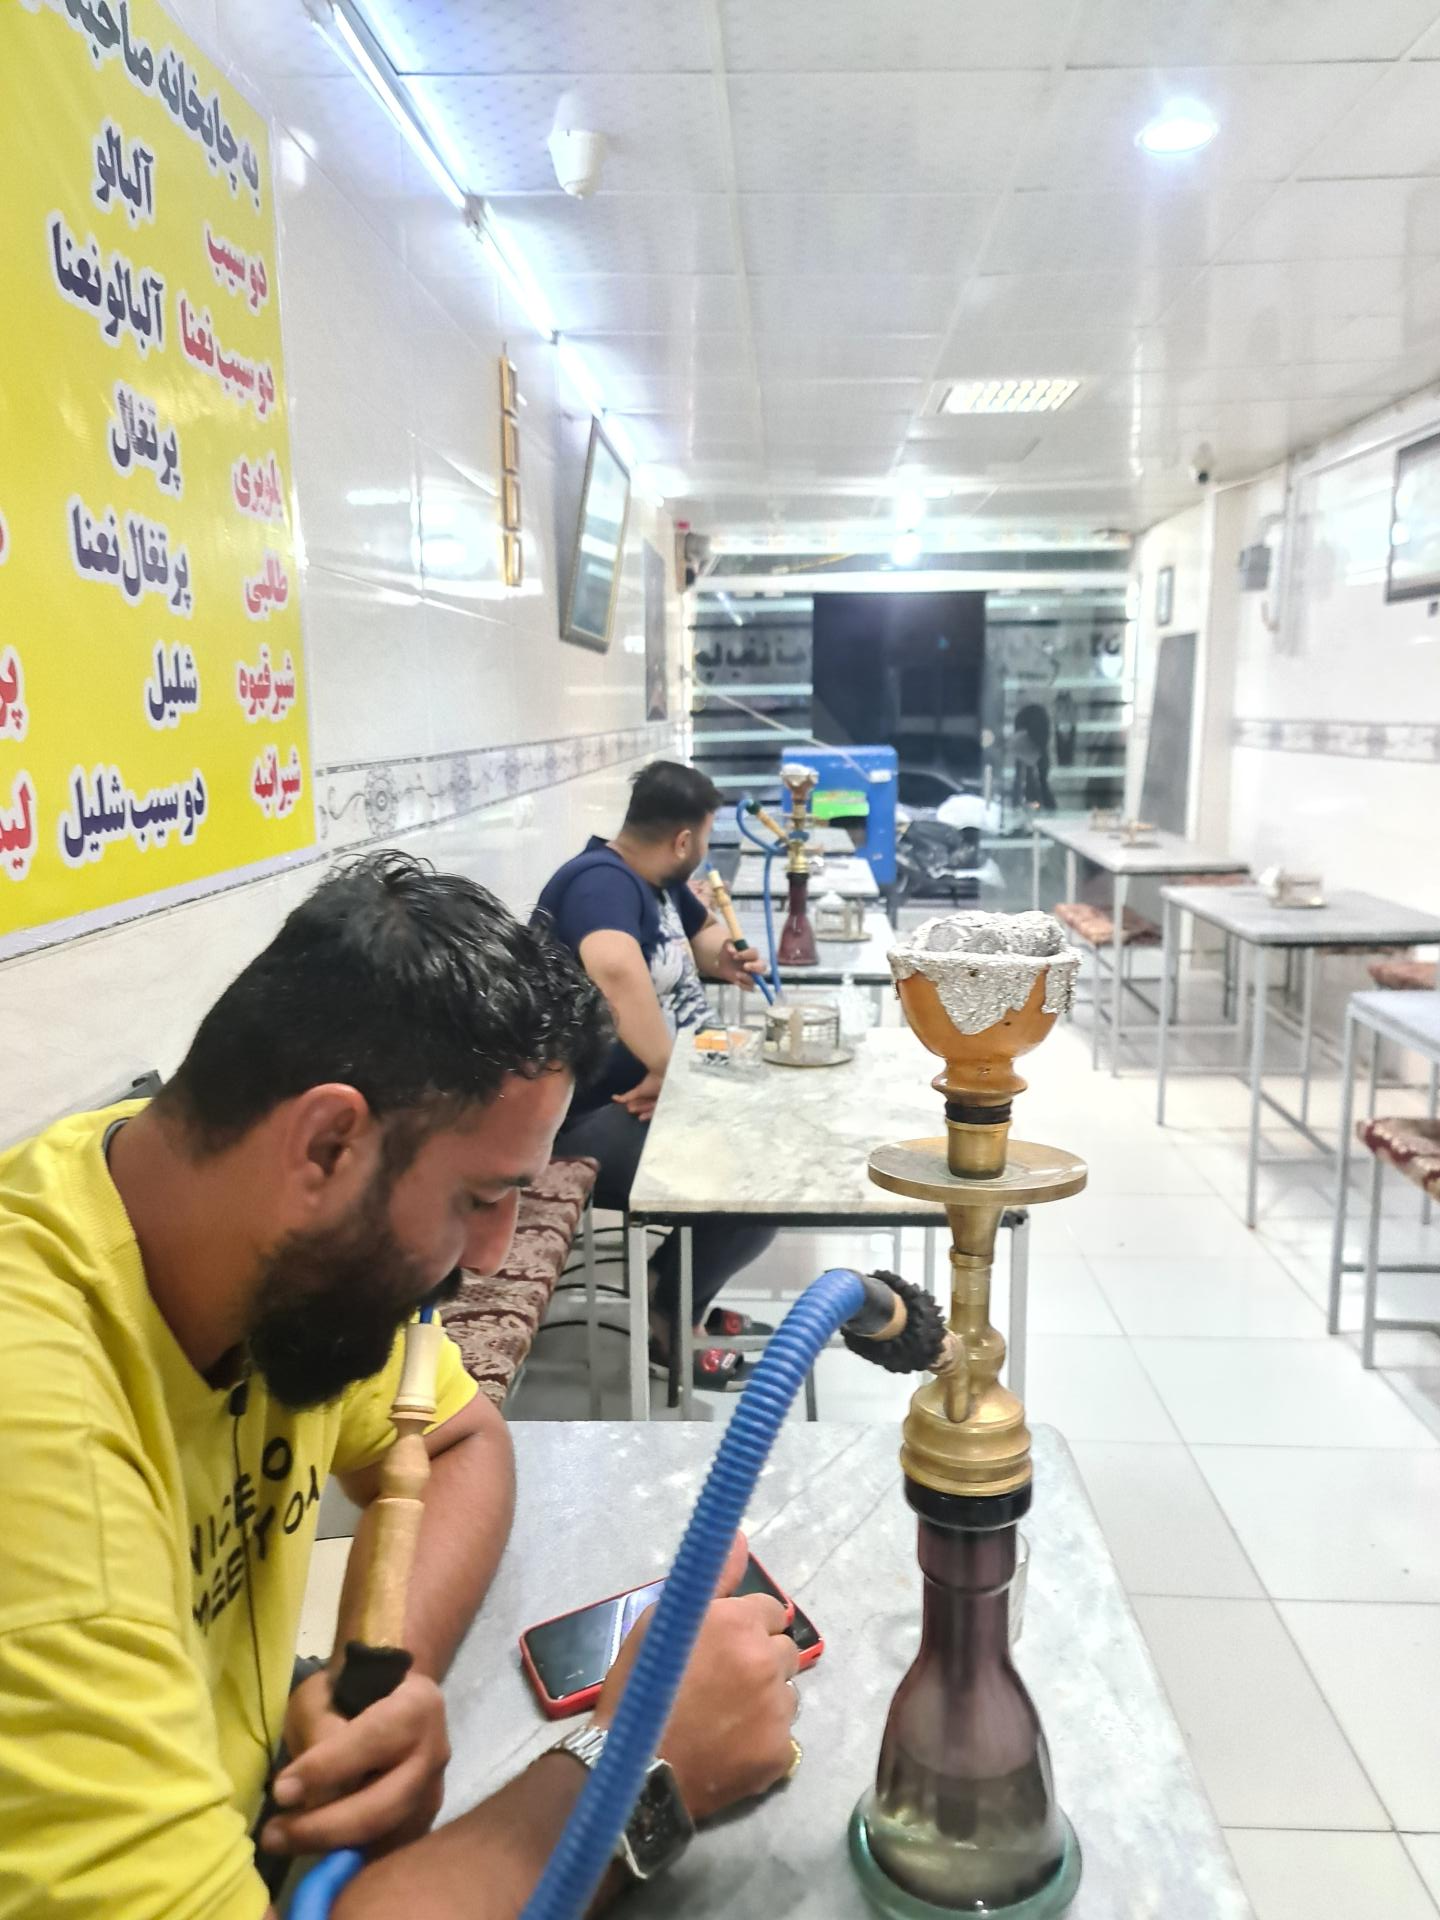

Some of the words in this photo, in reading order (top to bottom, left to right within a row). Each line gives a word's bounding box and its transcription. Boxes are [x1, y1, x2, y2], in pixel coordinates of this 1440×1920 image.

[97, 126, 153, 219] آلبالو
[53, 221, 101, 306] نعنا
[105, 260, 163, 349] آلبالو
[181, 299, 214, 367] نعنا
[73, 505, 119, 575] نعنا
[246, 560, 288, 613] طالبی
[149, 650, 197, 721] شلیل
[65, 774, 125, 858] شلیل
